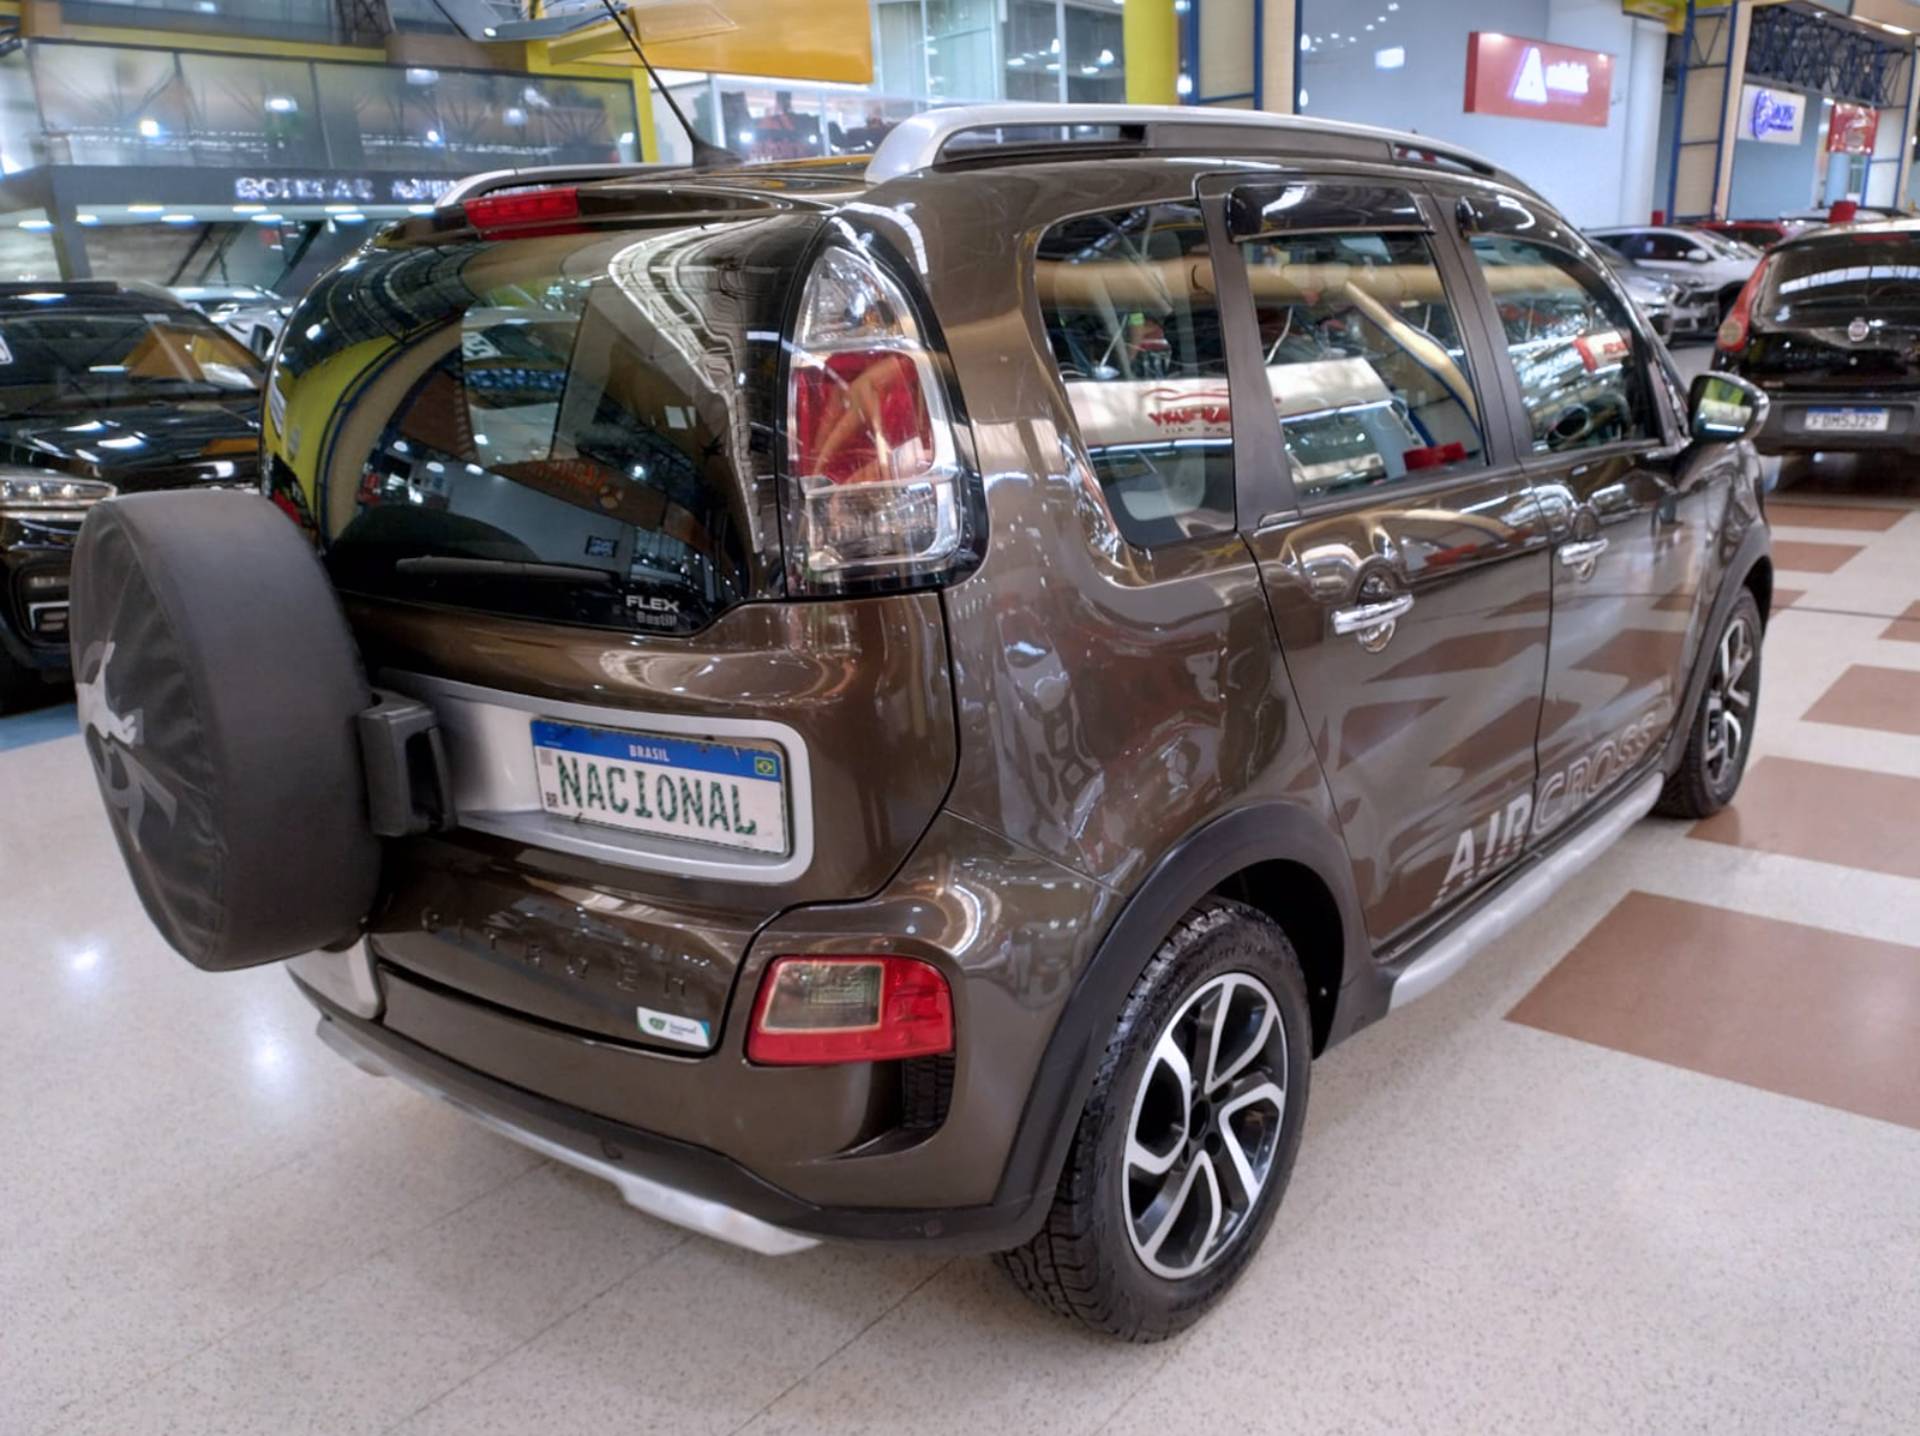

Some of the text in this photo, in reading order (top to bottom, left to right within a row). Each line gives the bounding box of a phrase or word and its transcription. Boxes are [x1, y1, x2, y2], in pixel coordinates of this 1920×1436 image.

[626, 594, 680, 613] FLEX
[628, 743, 671, 763] BRASIL
[556, 754, 757, 836] NACIONAL
